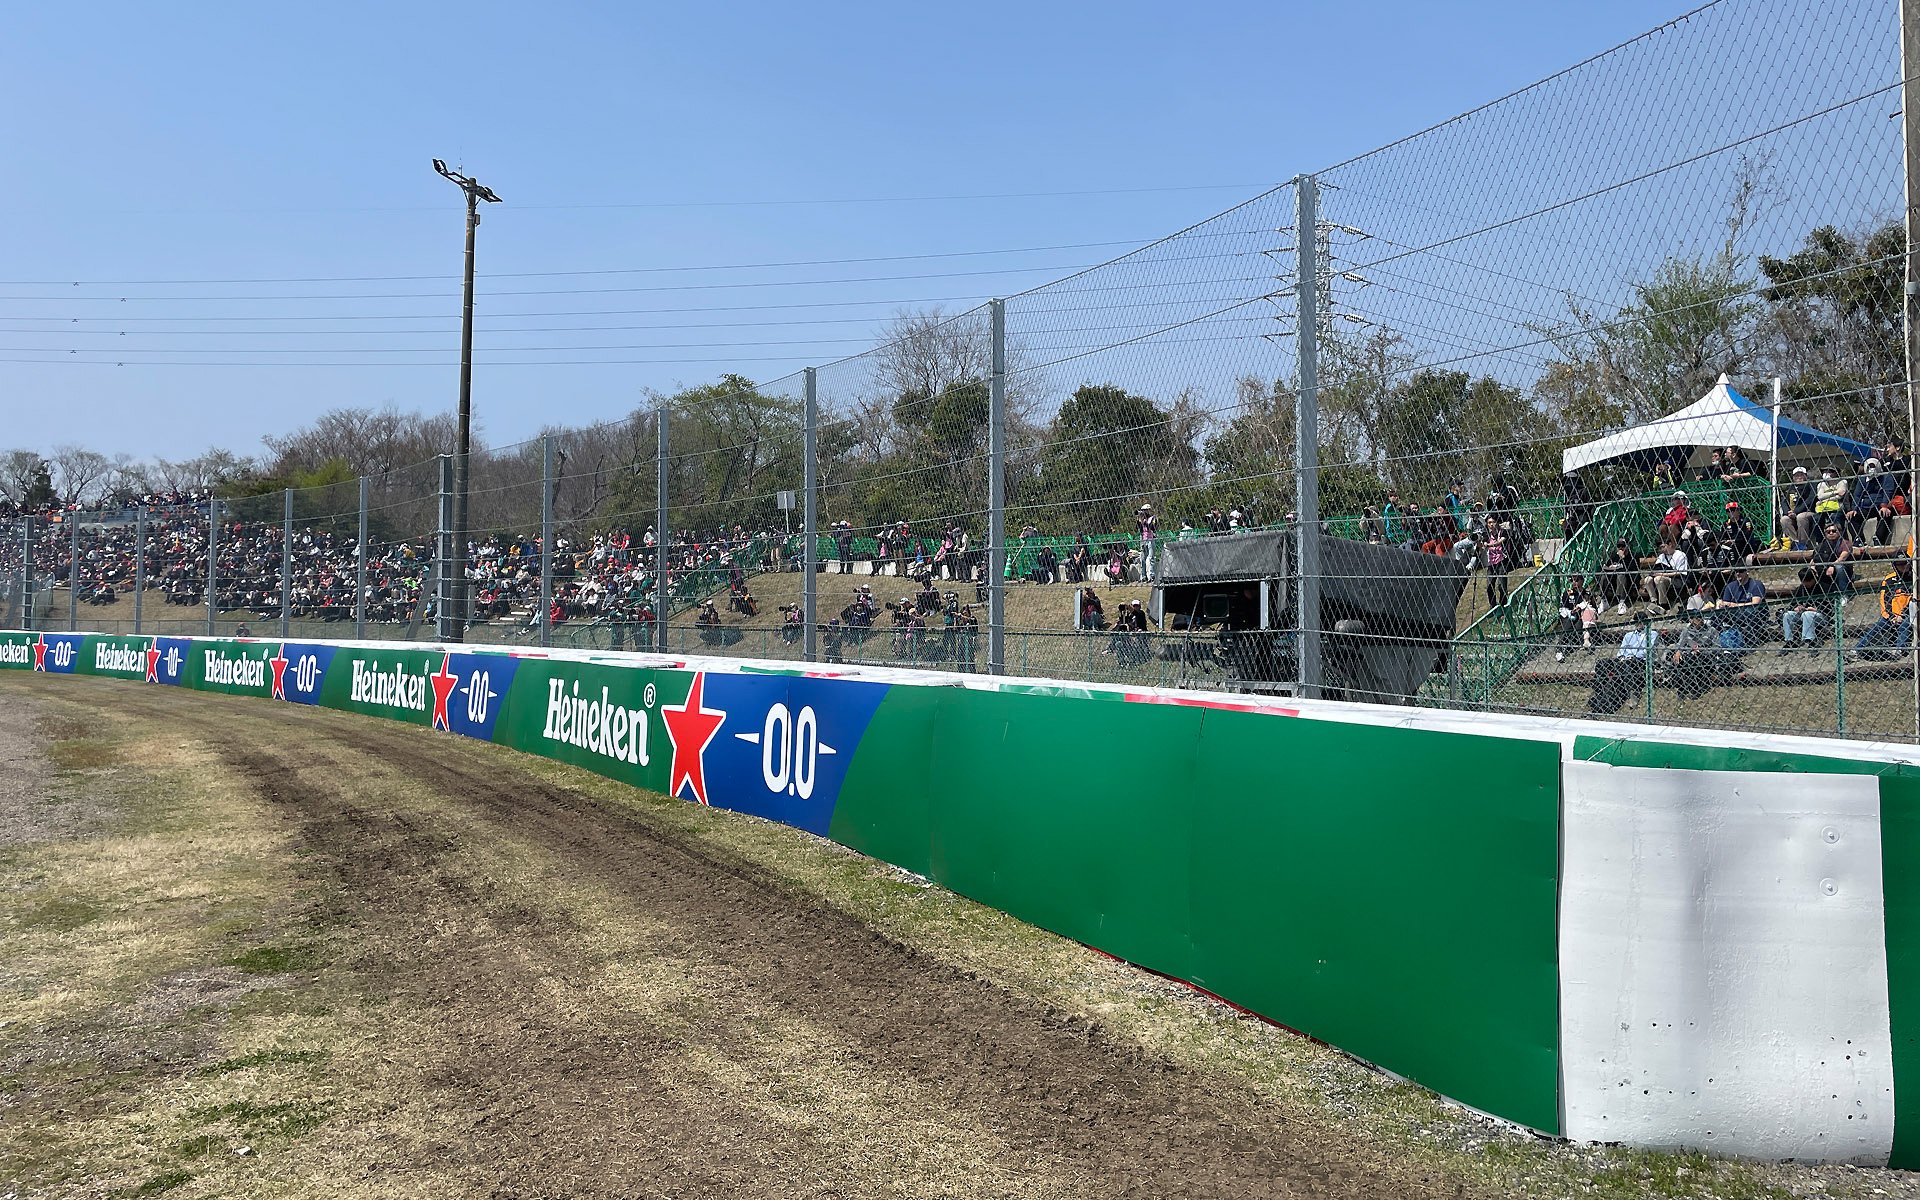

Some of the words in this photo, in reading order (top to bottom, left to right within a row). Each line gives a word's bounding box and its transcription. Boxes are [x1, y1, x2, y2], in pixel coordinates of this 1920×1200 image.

[204, 649, 265, 687] Heineken
[350, 659, 426, 712] Heineken
[542, 677, 650, 767] Heineken
